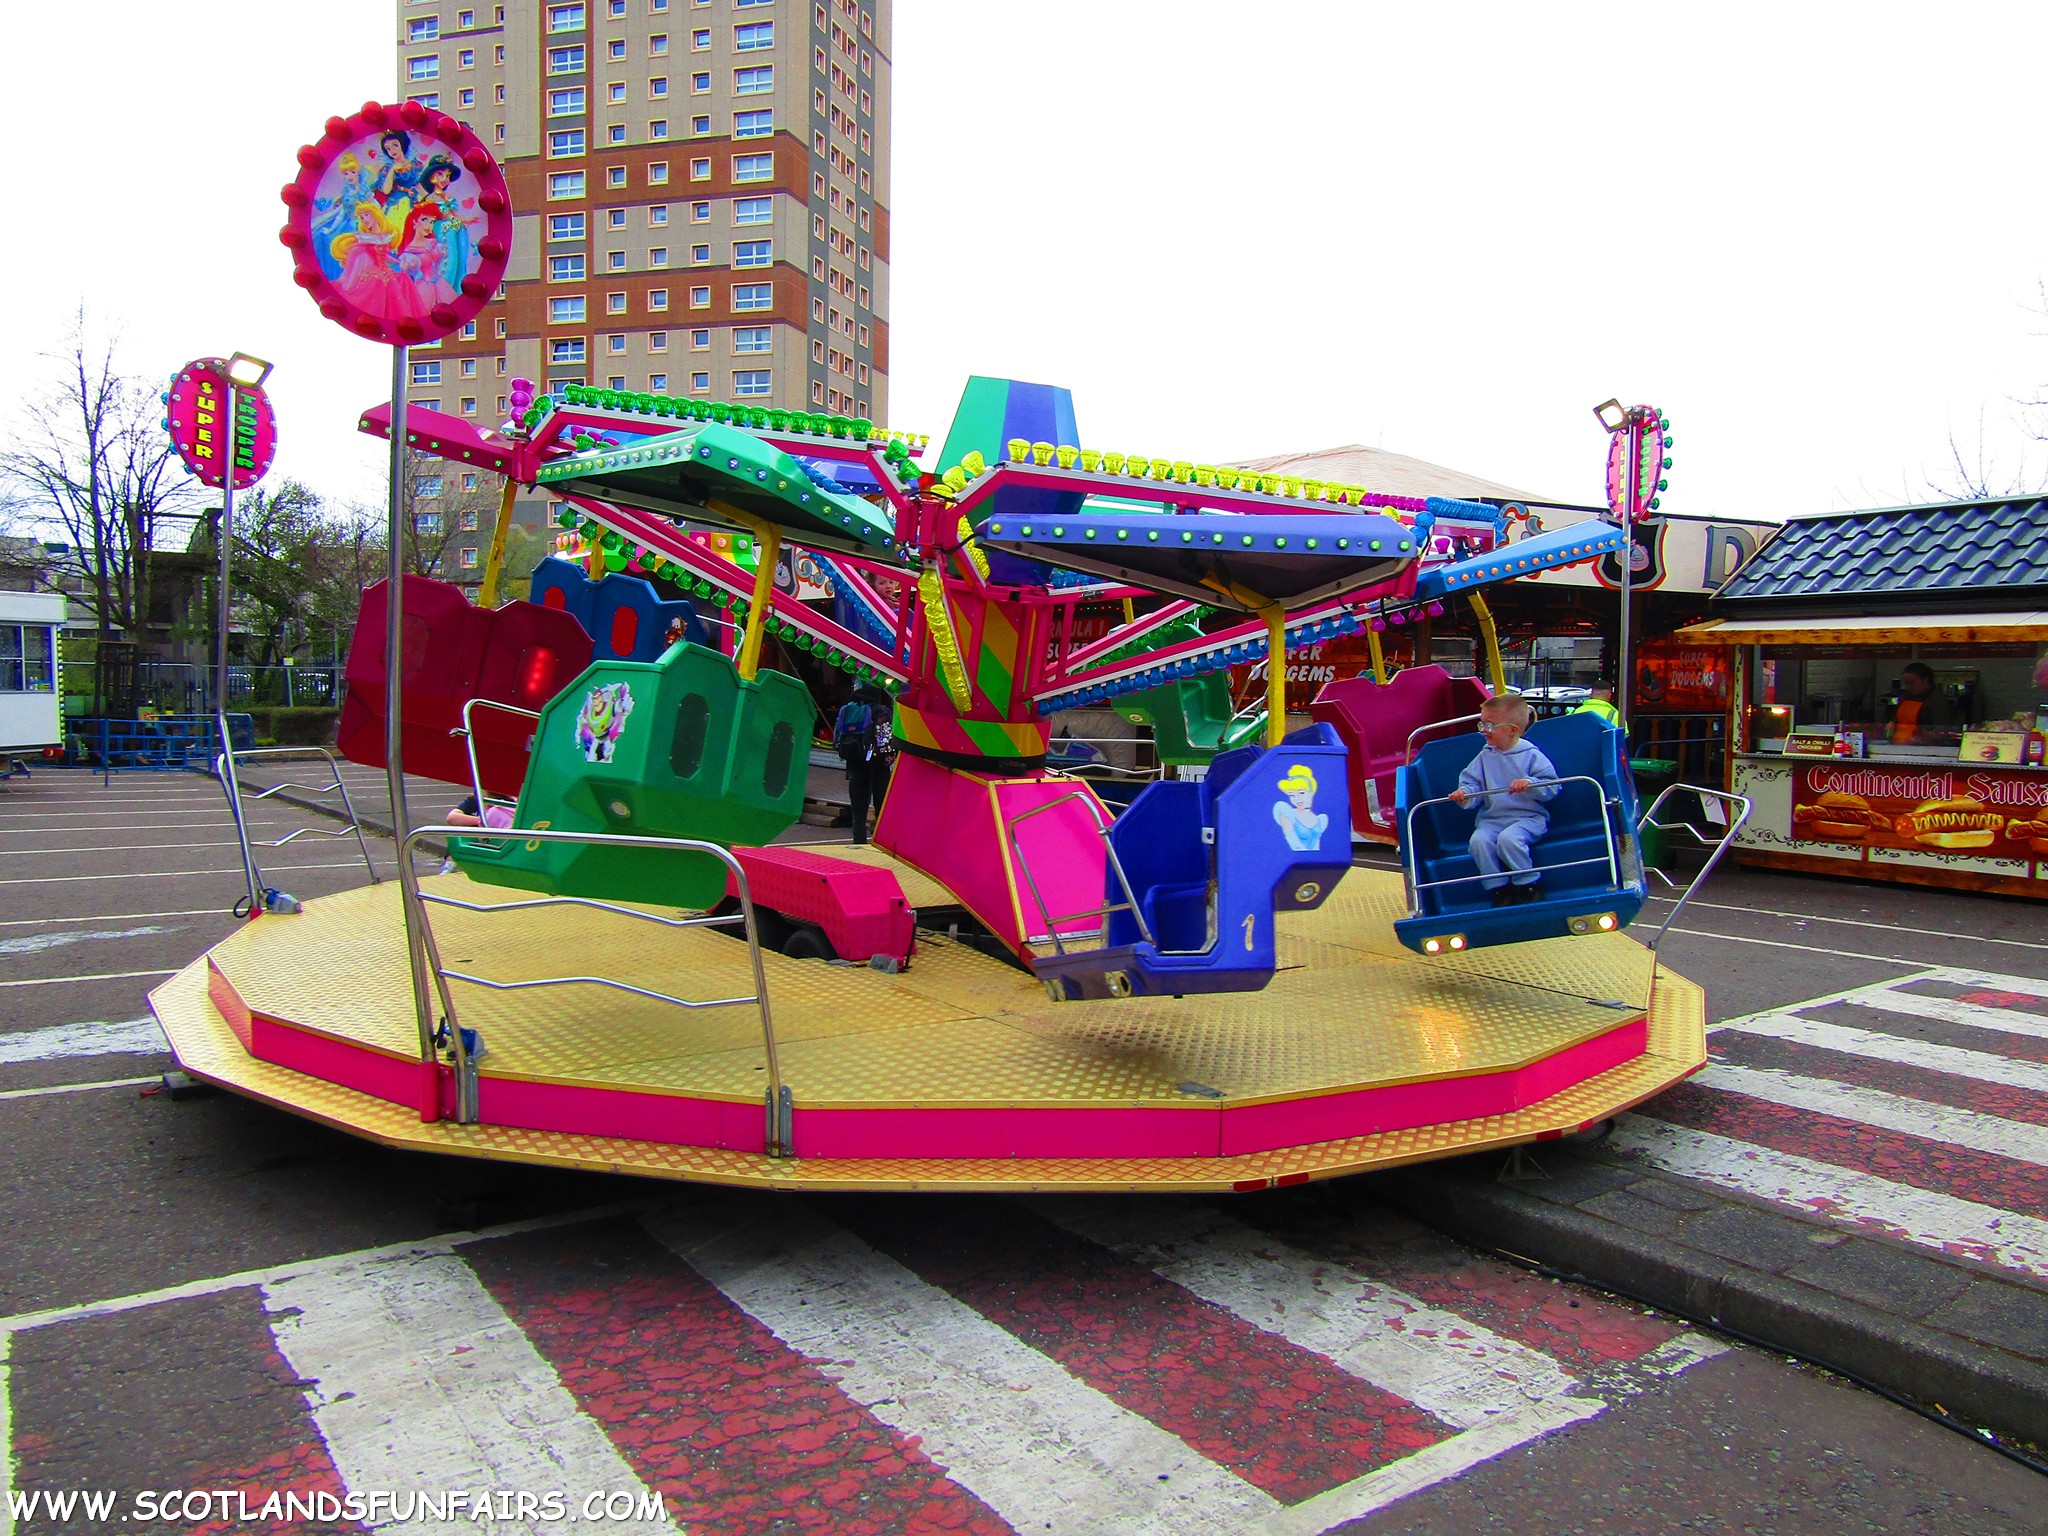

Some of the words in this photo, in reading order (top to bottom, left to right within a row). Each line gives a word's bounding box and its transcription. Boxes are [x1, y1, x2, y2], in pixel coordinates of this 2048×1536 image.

[195, 381, 216, 459] SUPER
[236, 392, 258, 469] TROOPER
[1251, 664, 1336, 682] DOGEMS
[1671, 670, 1714, 687] DODGEMS
[1807, 764, 1953, 801] Continental
[1241, 913, 1254, 951] 1
